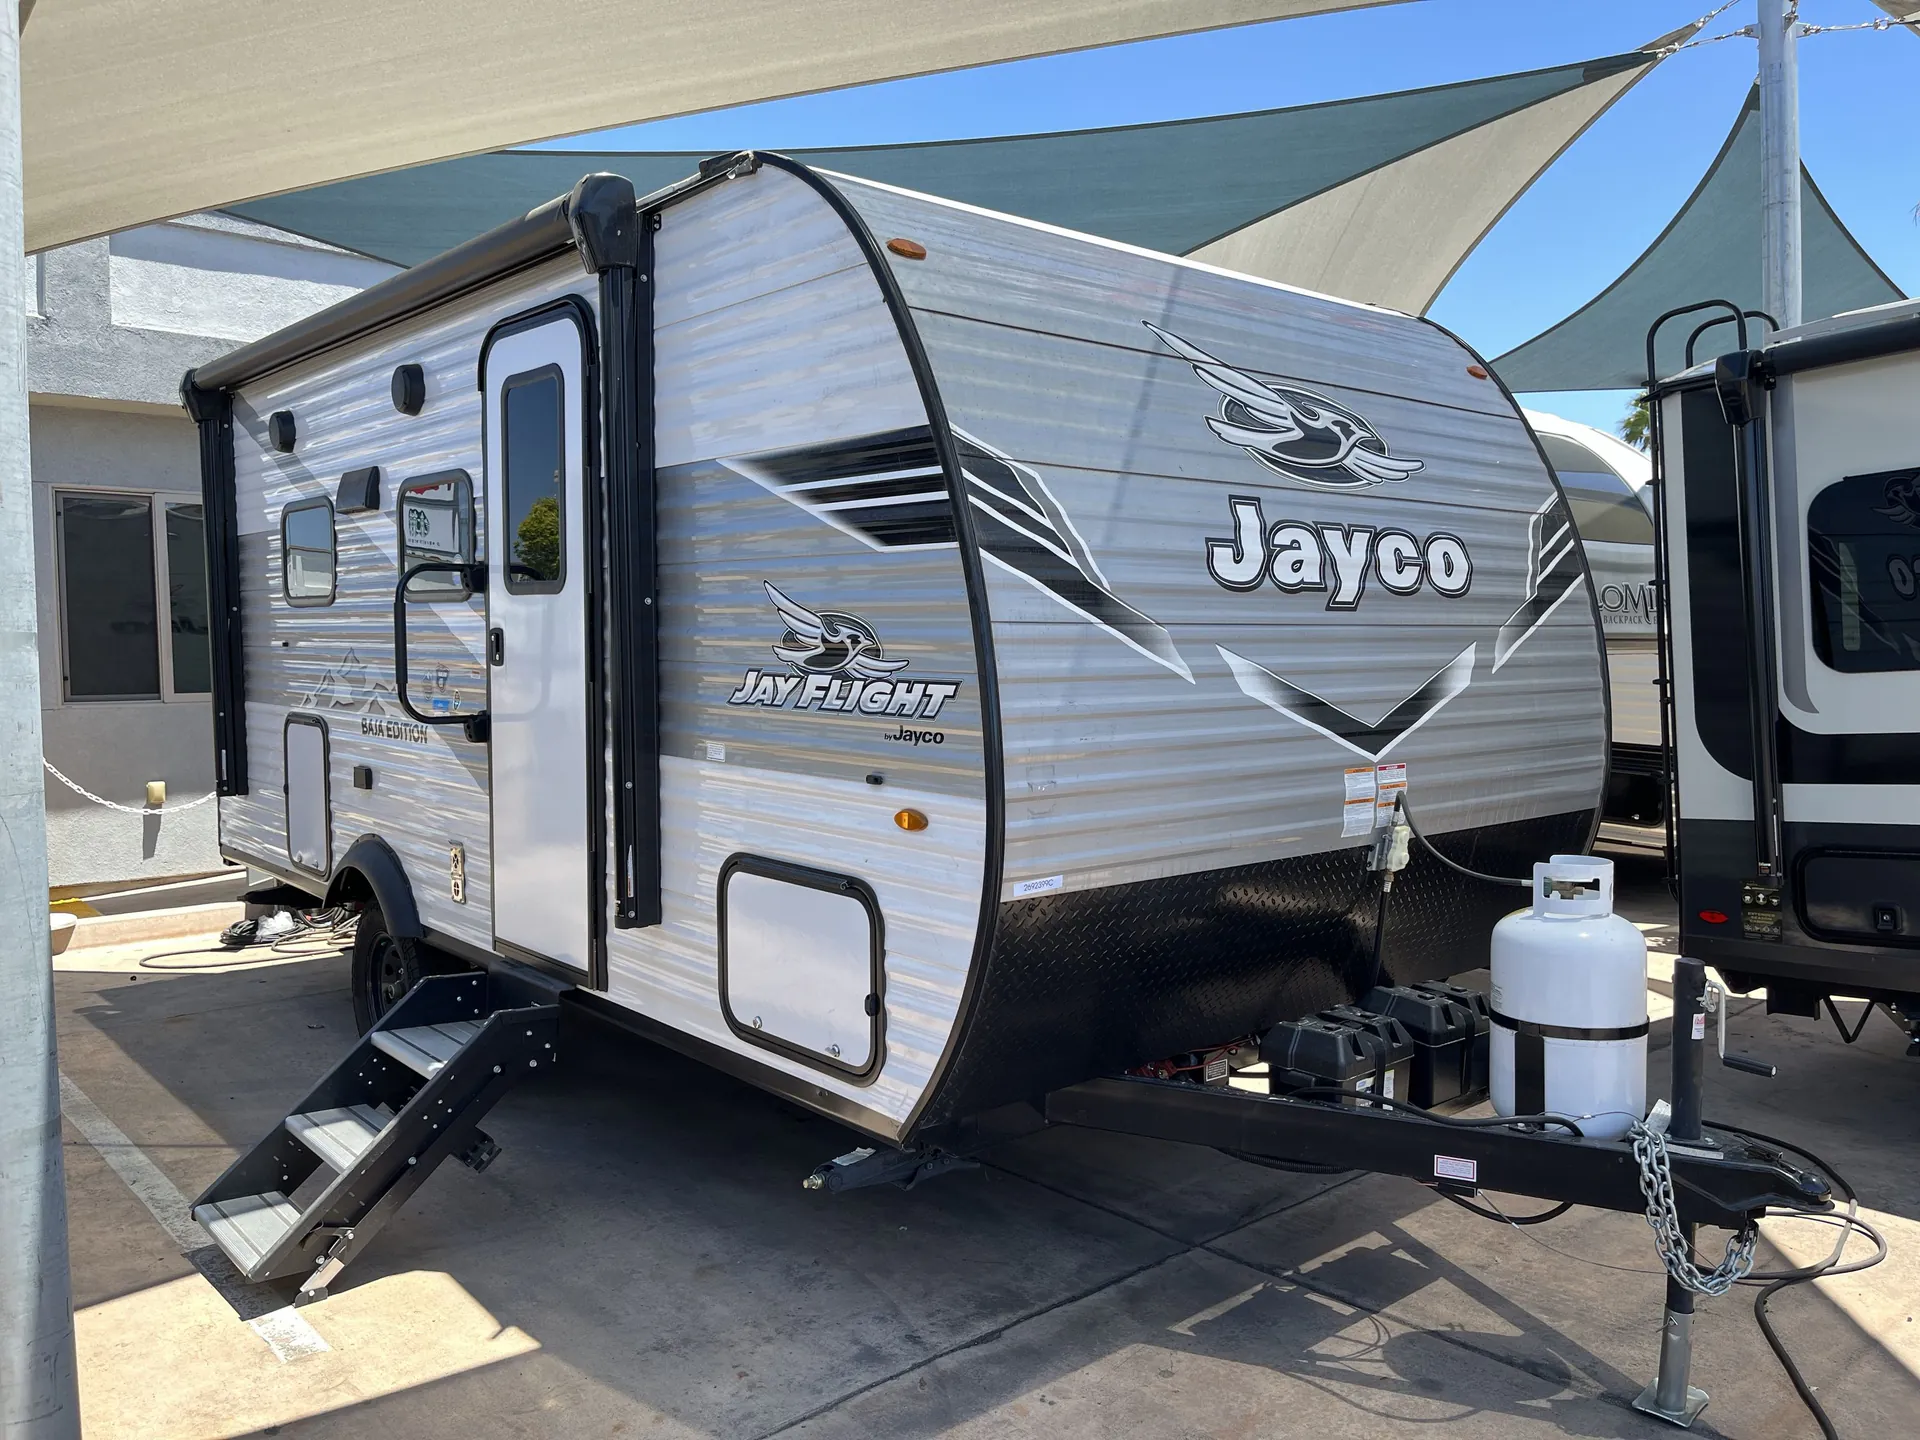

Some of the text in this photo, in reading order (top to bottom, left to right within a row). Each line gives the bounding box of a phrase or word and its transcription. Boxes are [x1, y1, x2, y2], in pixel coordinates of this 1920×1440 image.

[1205, 494, 1473, 611] Jayco
[1599, 582, 1657, 625] OMI
[1603, 615, 1643, 624] BACKPACK
[726, 668, 963, 722] JAY FLIGHT
[361, 717, 428, 743] BAJA EDITION
[884, 725, 944, 746] by Jayco
